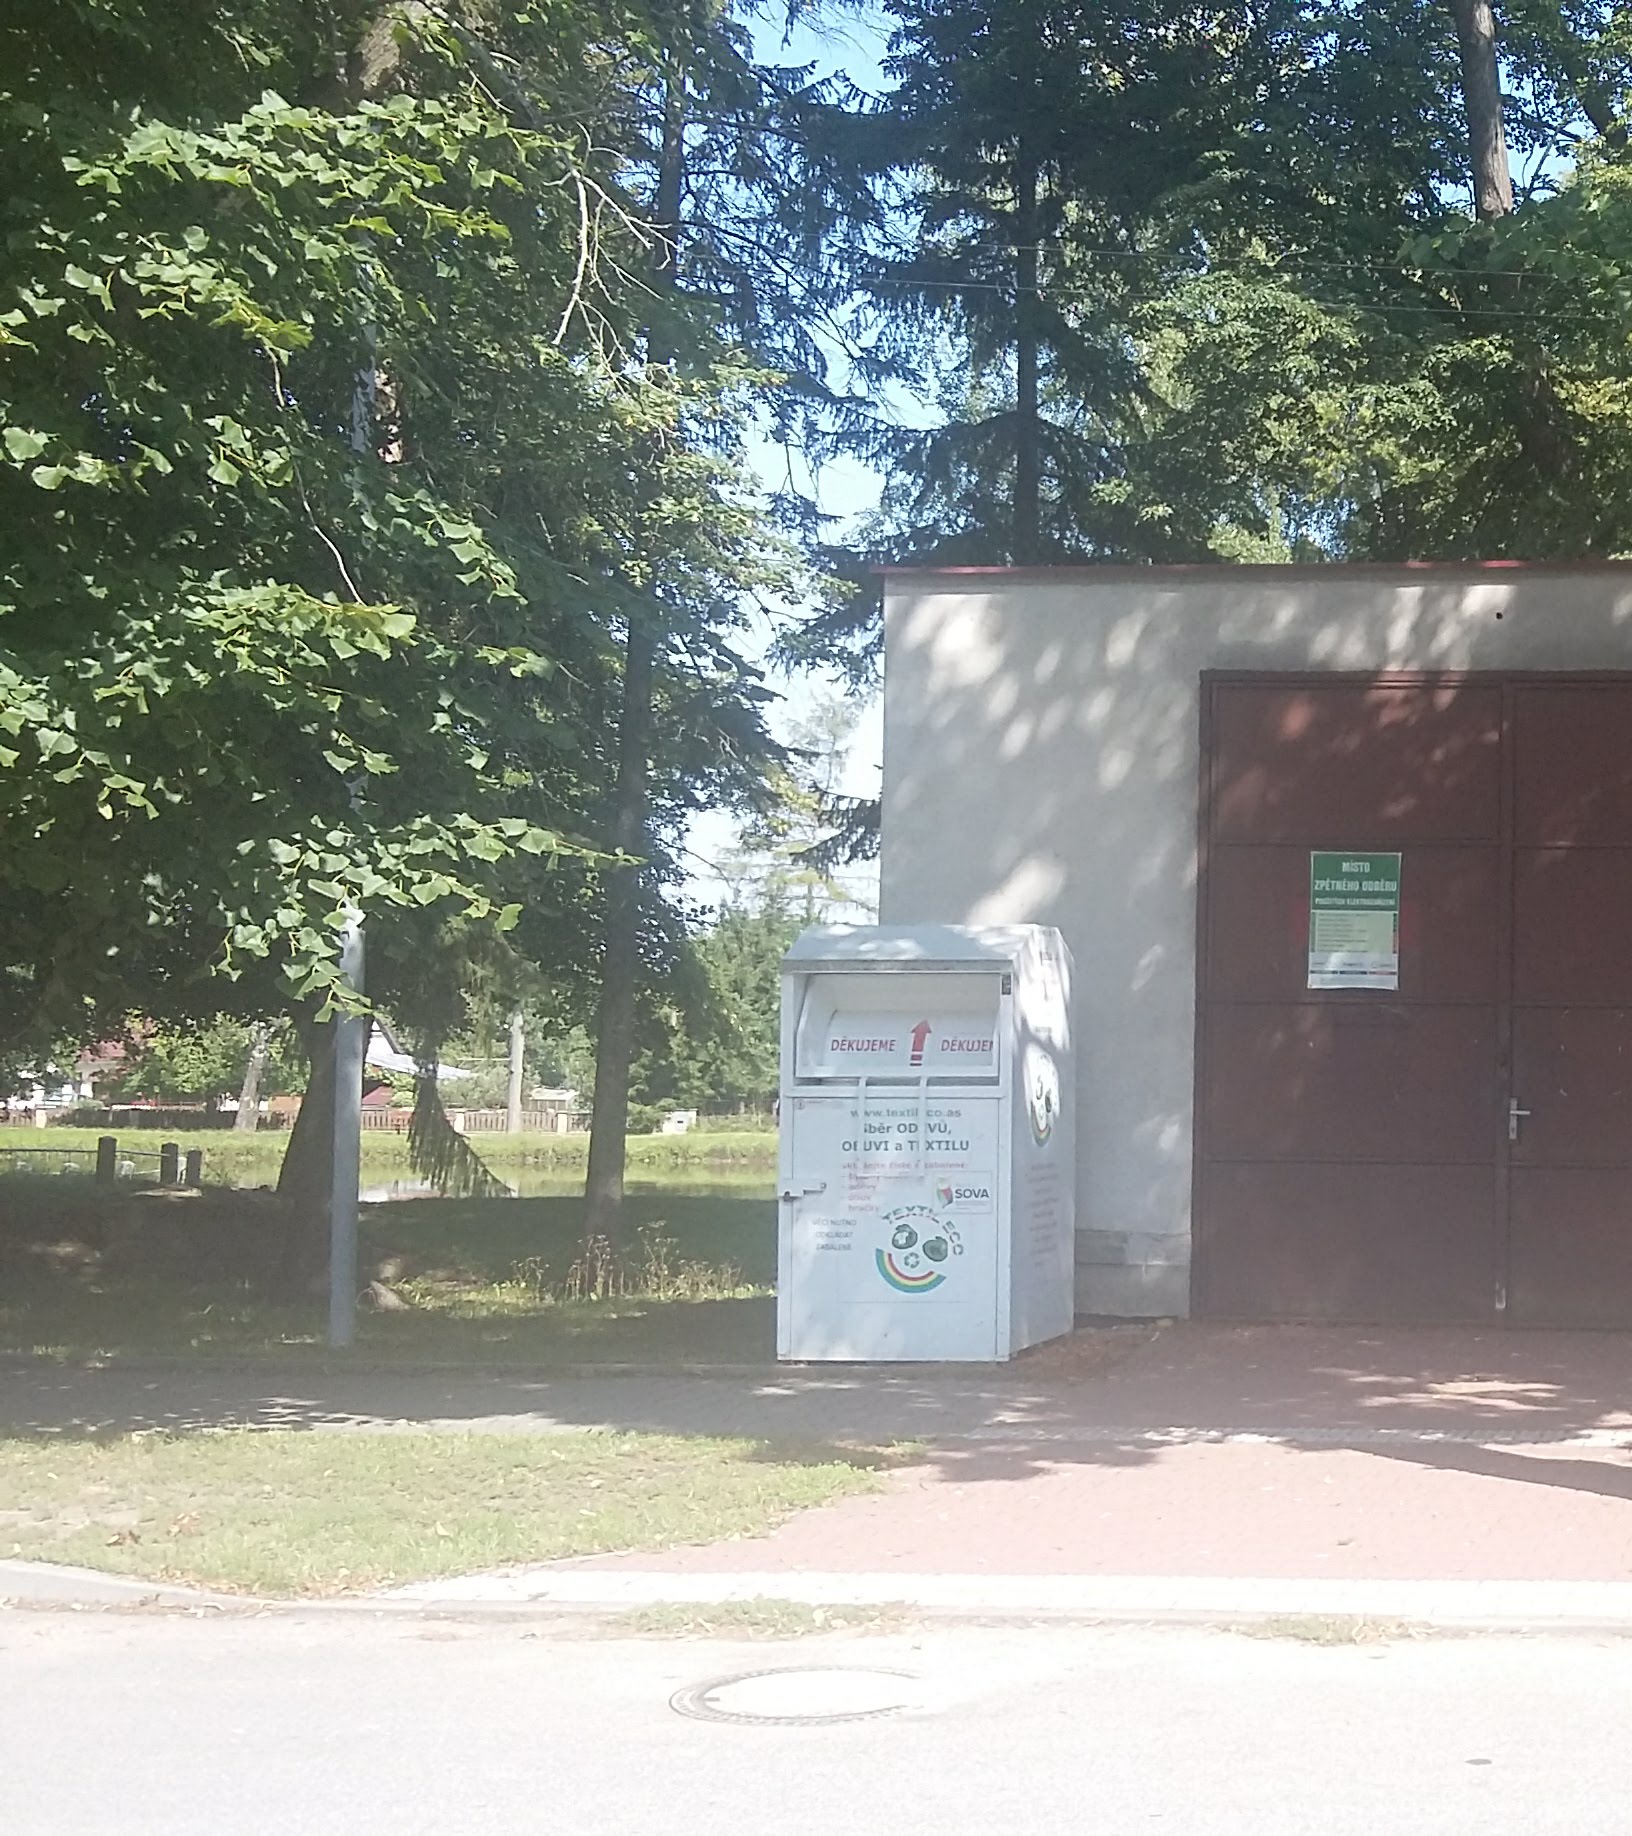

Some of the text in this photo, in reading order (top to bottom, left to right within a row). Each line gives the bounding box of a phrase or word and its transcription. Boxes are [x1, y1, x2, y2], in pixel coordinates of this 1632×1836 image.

[1342, 859, 1371, 873] MÍSTO
[1314, 878, 1397, 892] ZPĚTNÉHO ODBĚRU
[830, 1035, 896, 1052] DĚKUJEME
[896, 1120, 952, 1135] ODVŮ,
[894, 1142, 903, 1152] a
[907, 1139, 969, 1152] TXTILU
[954, 1188, 990, 1199] SOVA
